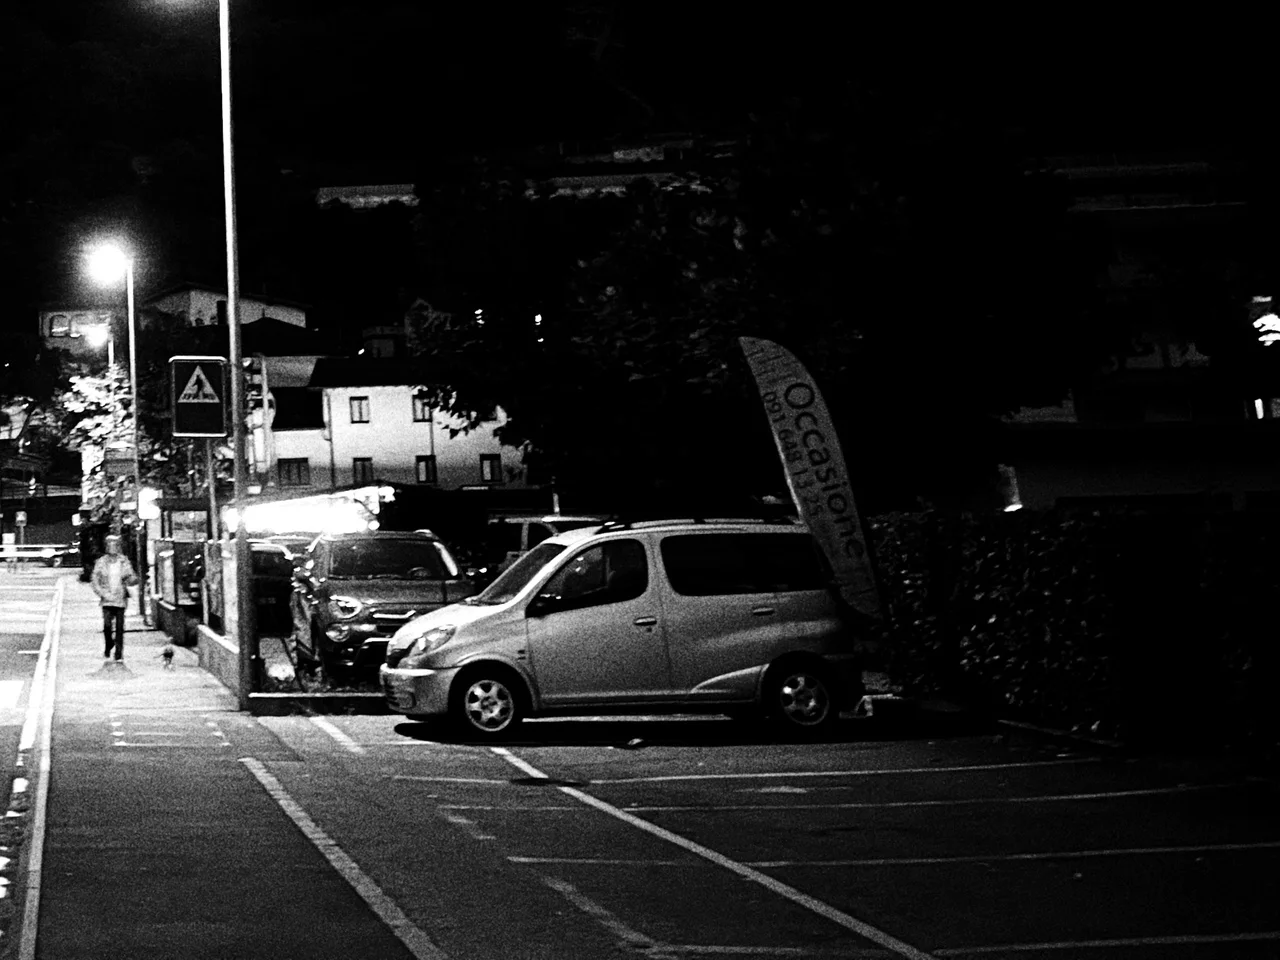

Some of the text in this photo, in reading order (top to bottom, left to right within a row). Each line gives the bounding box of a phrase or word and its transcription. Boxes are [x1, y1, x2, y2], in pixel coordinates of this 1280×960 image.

[762, 392, 786, 423] 091
[792, 467, 813, 490] 13
[784, 382, 864, 559] Occasione
